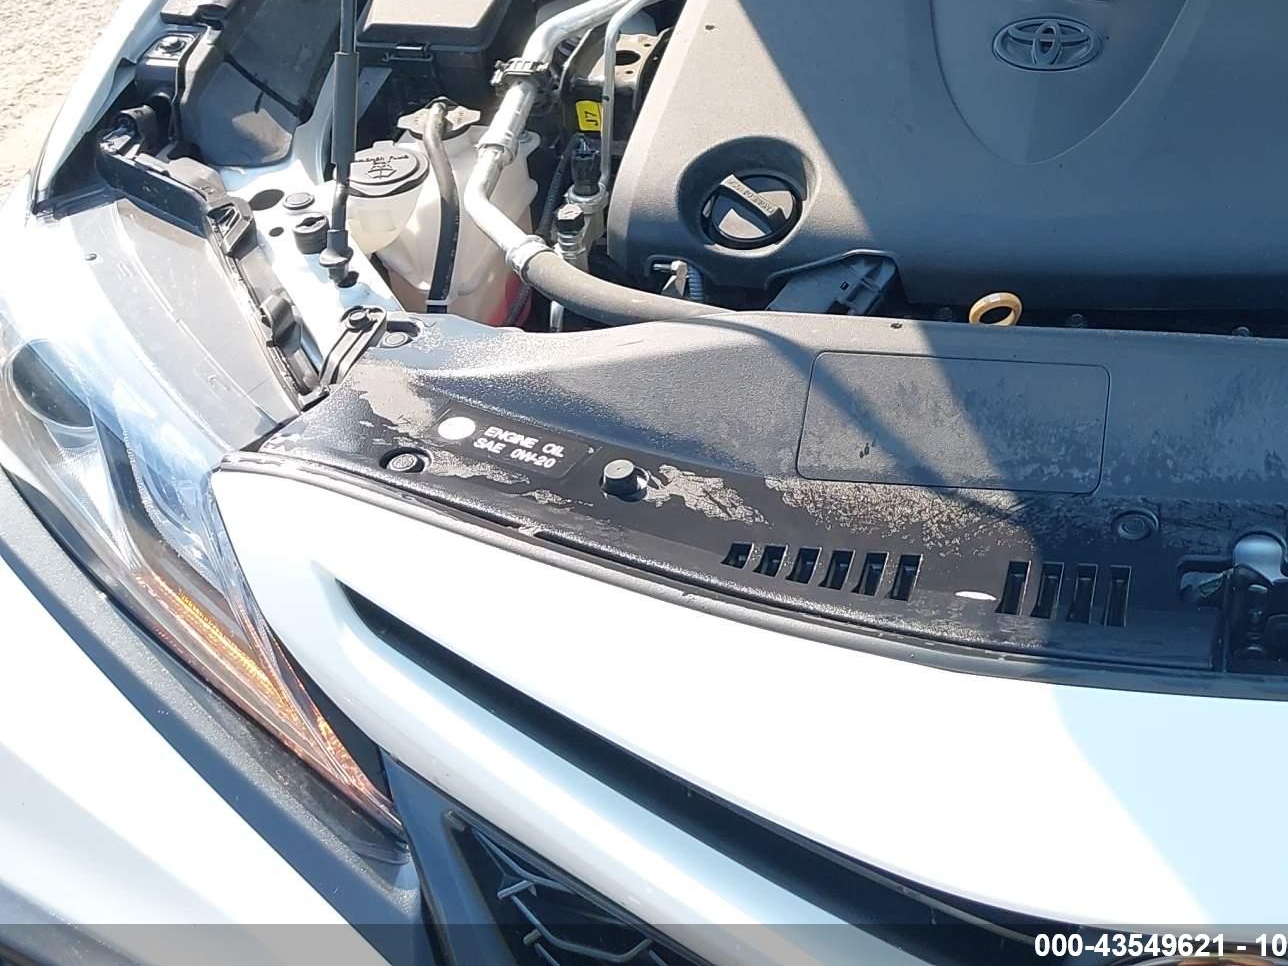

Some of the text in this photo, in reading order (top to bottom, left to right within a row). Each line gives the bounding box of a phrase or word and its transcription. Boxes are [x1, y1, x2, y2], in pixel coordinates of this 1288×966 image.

[473, 437, 557, 469] SAE 0W-20
[484, 425, 565, 458] ENGINE OIL
